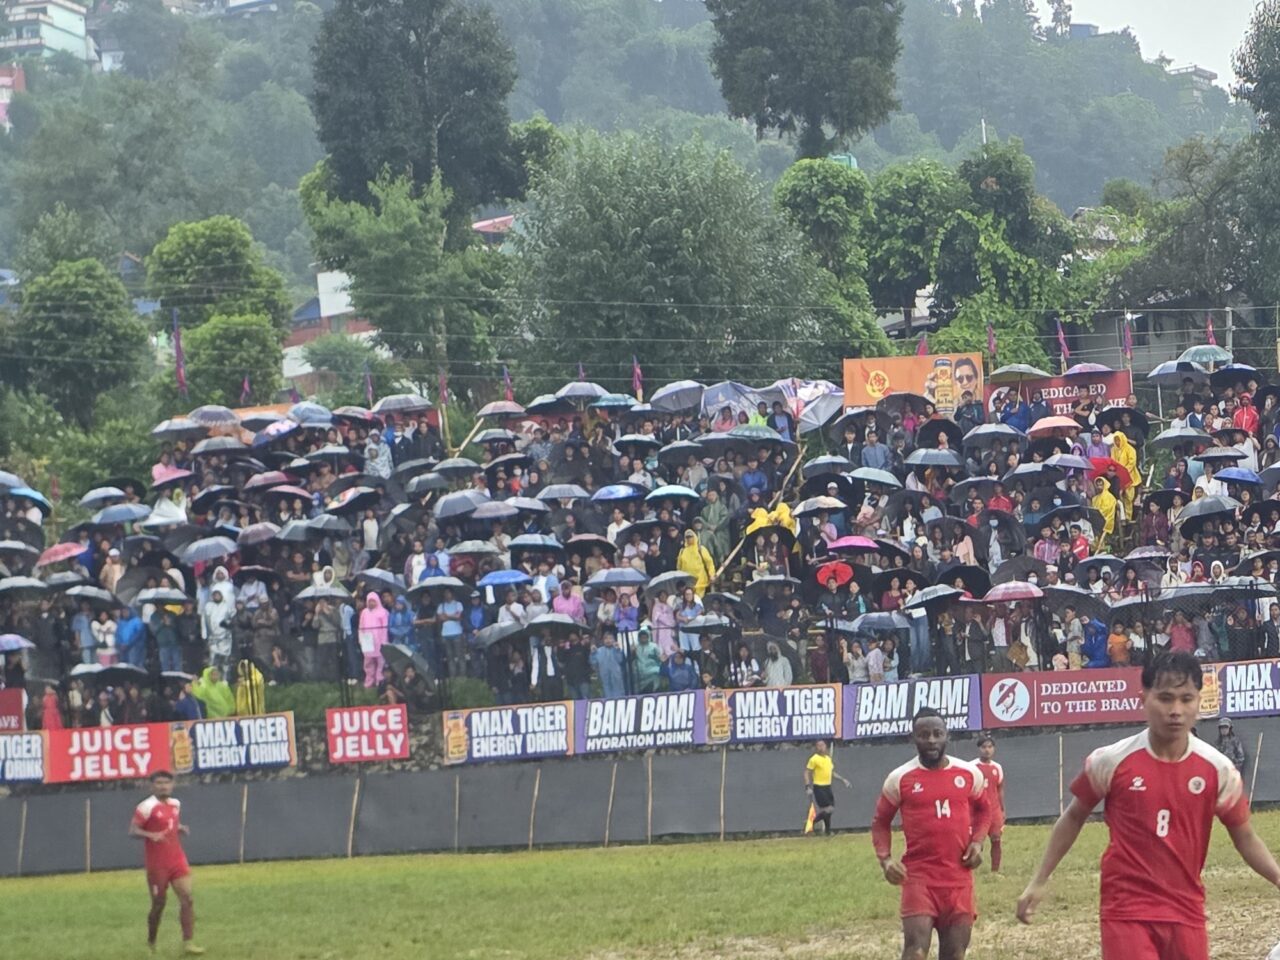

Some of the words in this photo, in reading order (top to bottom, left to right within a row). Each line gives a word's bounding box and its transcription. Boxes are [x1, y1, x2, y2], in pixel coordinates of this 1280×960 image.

[1041, 383, 1106, 399] EDICAED
[1040, 680, 1127, 696] DEDICATED
[1226, 662, 1272, 692] MAX
[588, 698, 637, 736] BAM
[640, 693, 695, 732] BAM!
[736, 690, 779, 718] MAX
[784, 688, 834, 716] TIGER
[858, 682, 908, 722] BAM
[1040, 702, 1062, 714] TO
[1065, 700, 1096, 713] THE
[1100, 698, 1144, 712] BRAV
[195, 720, 237, 748] MAX
[240, 716, 288, 744] TIGER
[330, 708, 403, 735] JUICE
[472, 709, 514, 738] MAX
[517, 705, 566, 734] TIGER
[736, 716, 788, 738] ENERGY
[792, 714, 836, 736] DRINK
[68, 726, 150, 755] JUICE
[332, 732, 404, 758] JELLY
[472, 734, 522, 758] ENERGY
[526, 731, 568, 754] DRINK
[586, 734, 654, 751] HYDRATION
[656, 730, 692, 745] DRINK
[70, 752, 152, 780] JELLY
[198, 746, 248, 768] ENERGY
[250, 742, 290, 764] DRINK
[5, 759, 44, 780] DRINK
[935, 799, 950, 819] 14
[1156, 808, 1170, 838] 8
